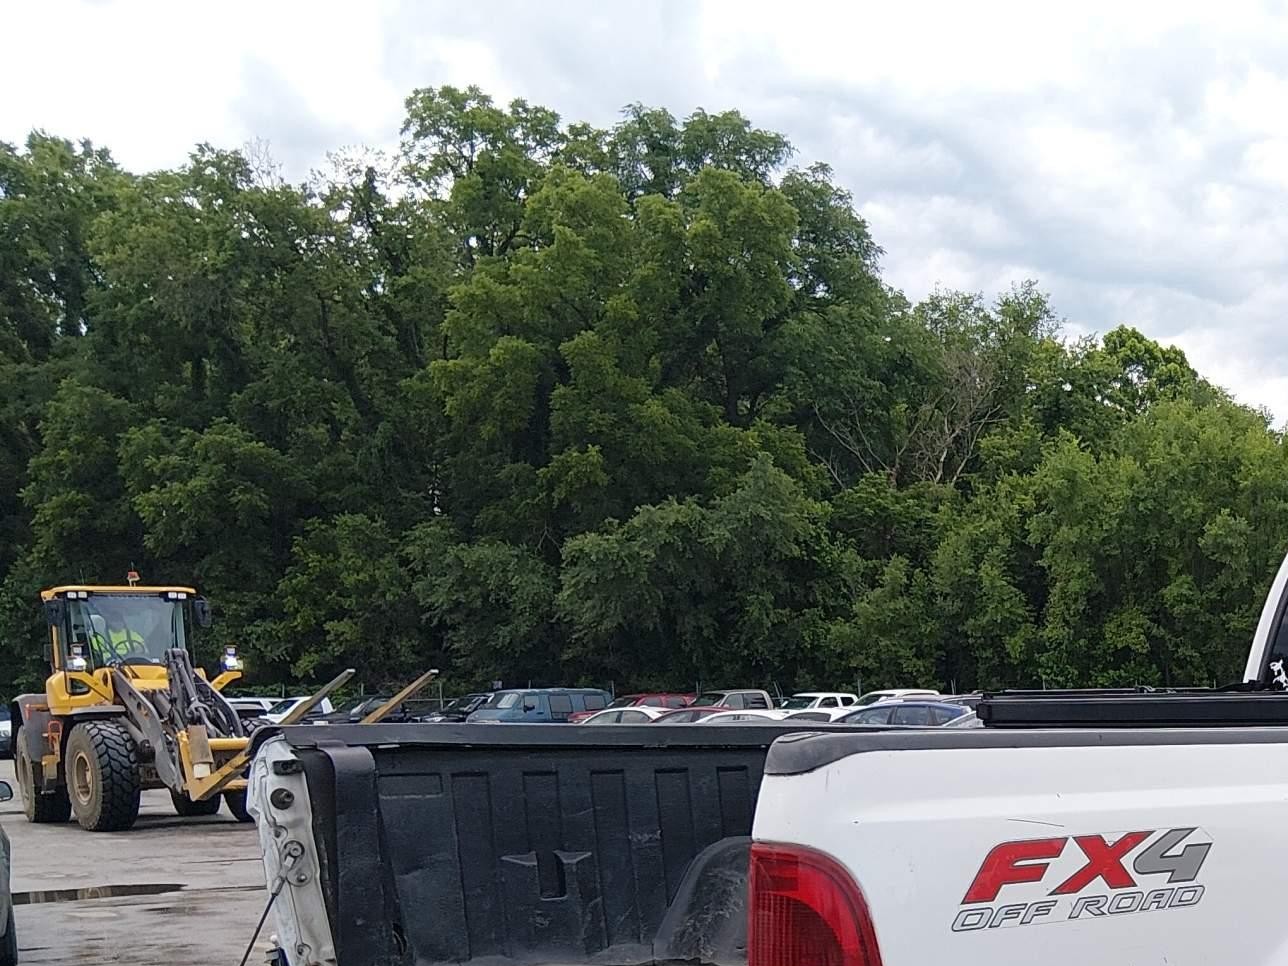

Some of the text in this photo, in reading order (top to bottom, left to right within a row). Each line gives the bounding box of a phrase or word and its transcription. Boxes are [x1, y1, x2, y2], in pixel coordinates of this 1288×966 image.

[960, 826, 1213, 905] FX4
[951, 885, 1206, 932] OFF ROAD
